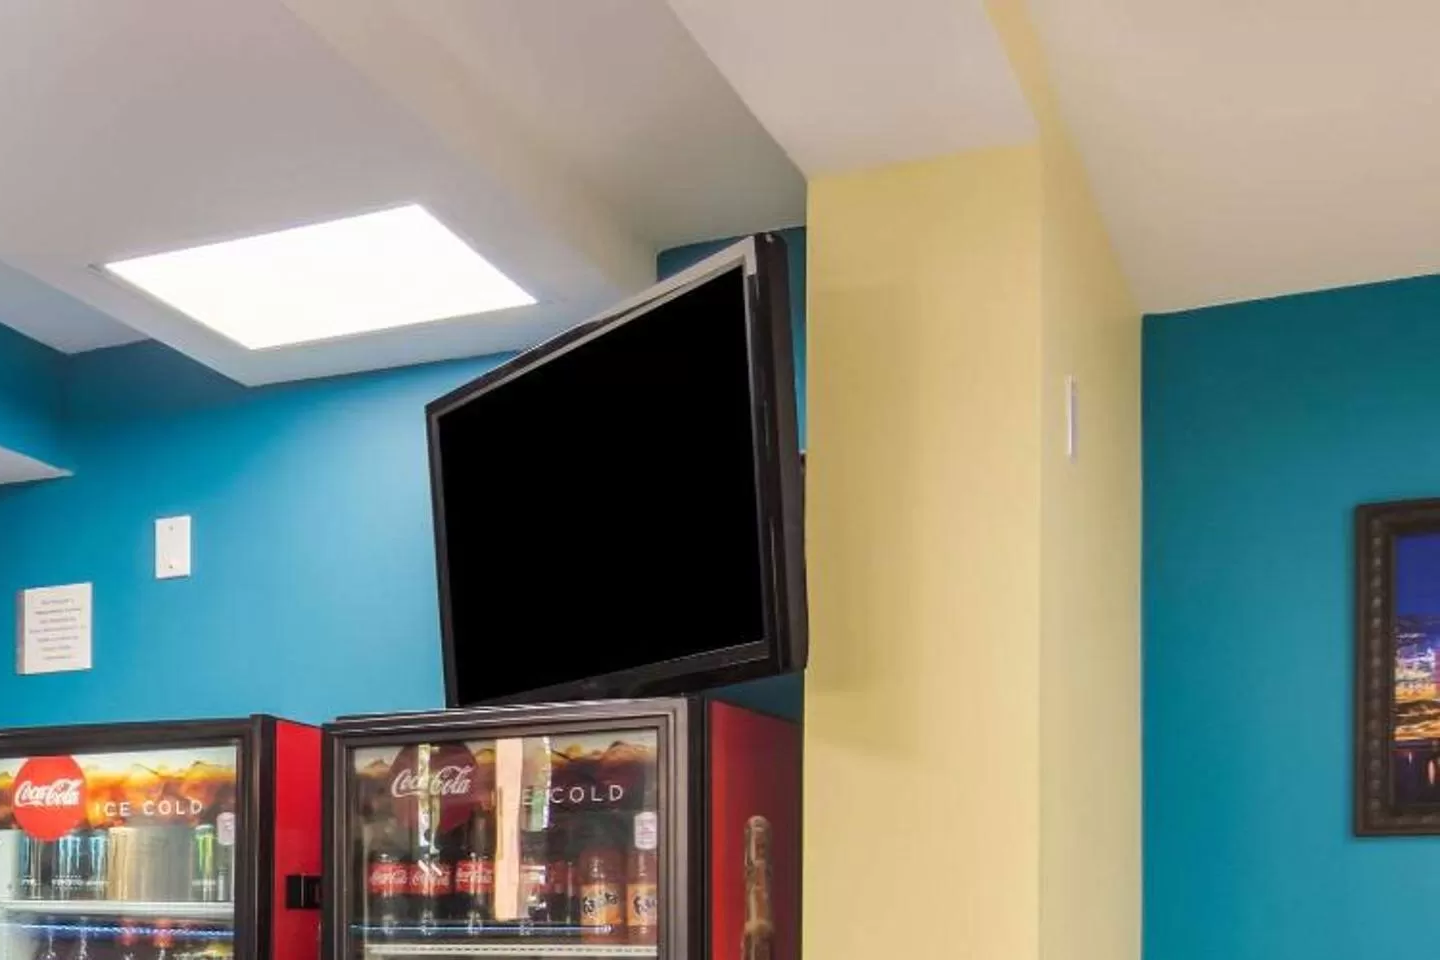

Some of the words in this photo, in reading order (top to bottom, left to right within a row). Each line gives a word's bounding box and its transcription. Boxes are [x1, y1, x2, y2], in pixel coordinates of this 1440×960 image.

[15, 779, 83, 807] Coca-Cola
[550, 784, 624, 804] COLD
[94, 801, 132, 818] ICE
[143, 799, 203, 816] COLD
